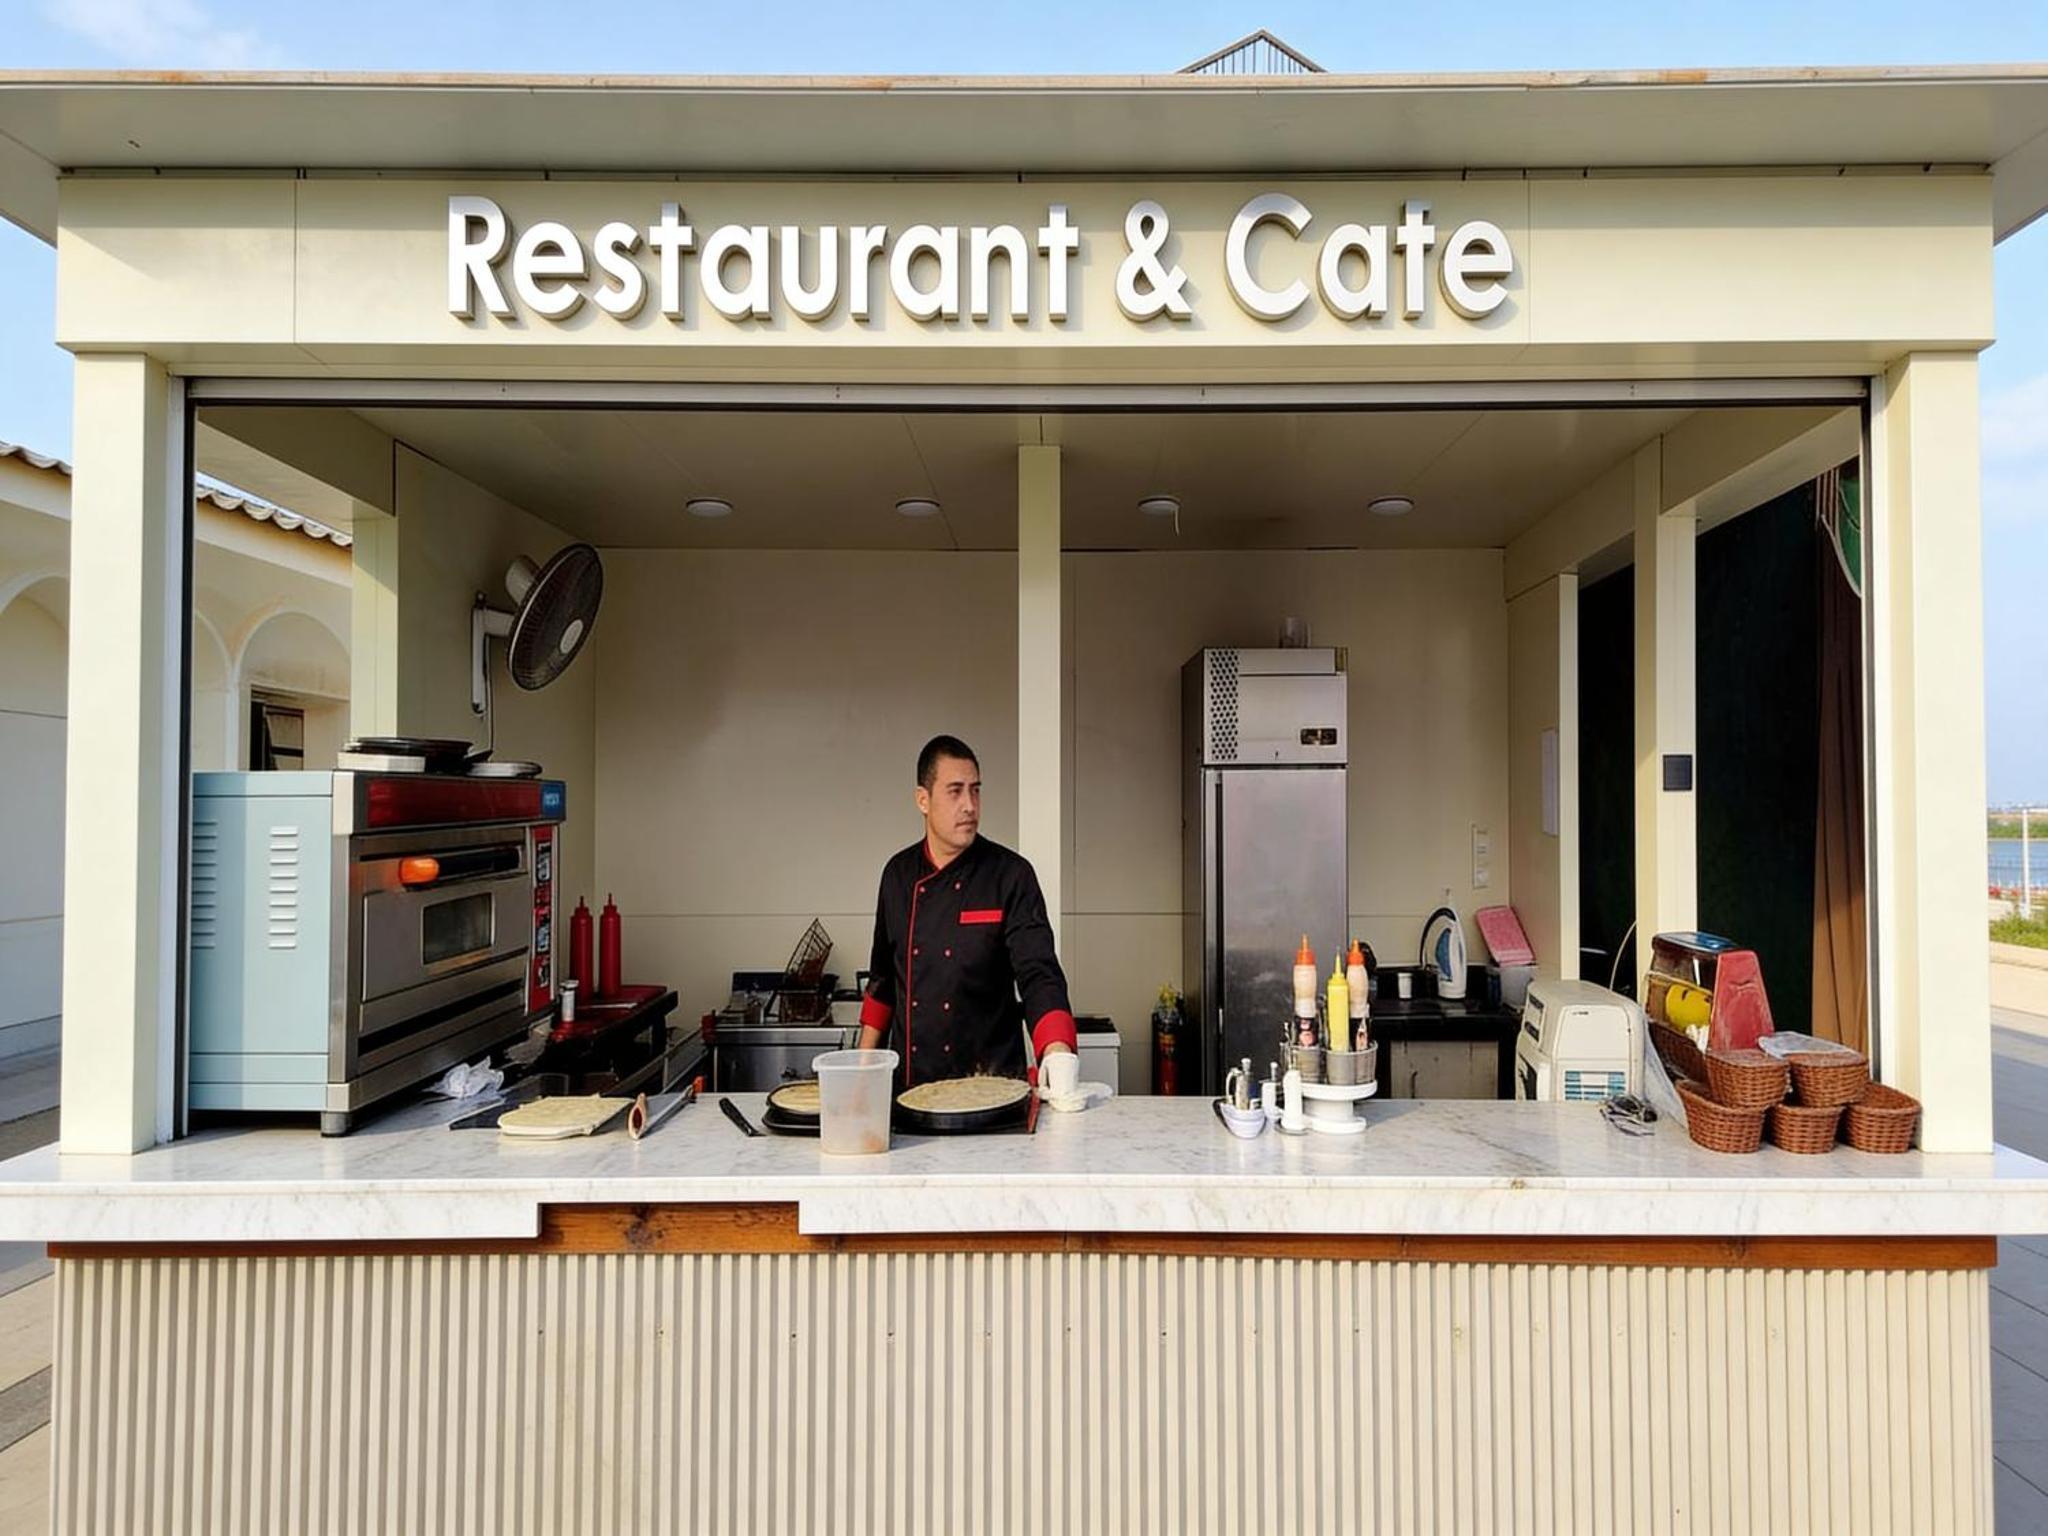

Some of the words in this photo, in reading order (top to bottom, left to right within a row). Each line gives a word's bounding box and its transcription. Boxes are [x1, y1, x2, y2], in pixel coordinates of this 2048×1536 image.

[447, 195, 1080, 321] Restaurant
[1115, 199, 1193, 322] &
[1224, 192, 1515, 322] Cafe
